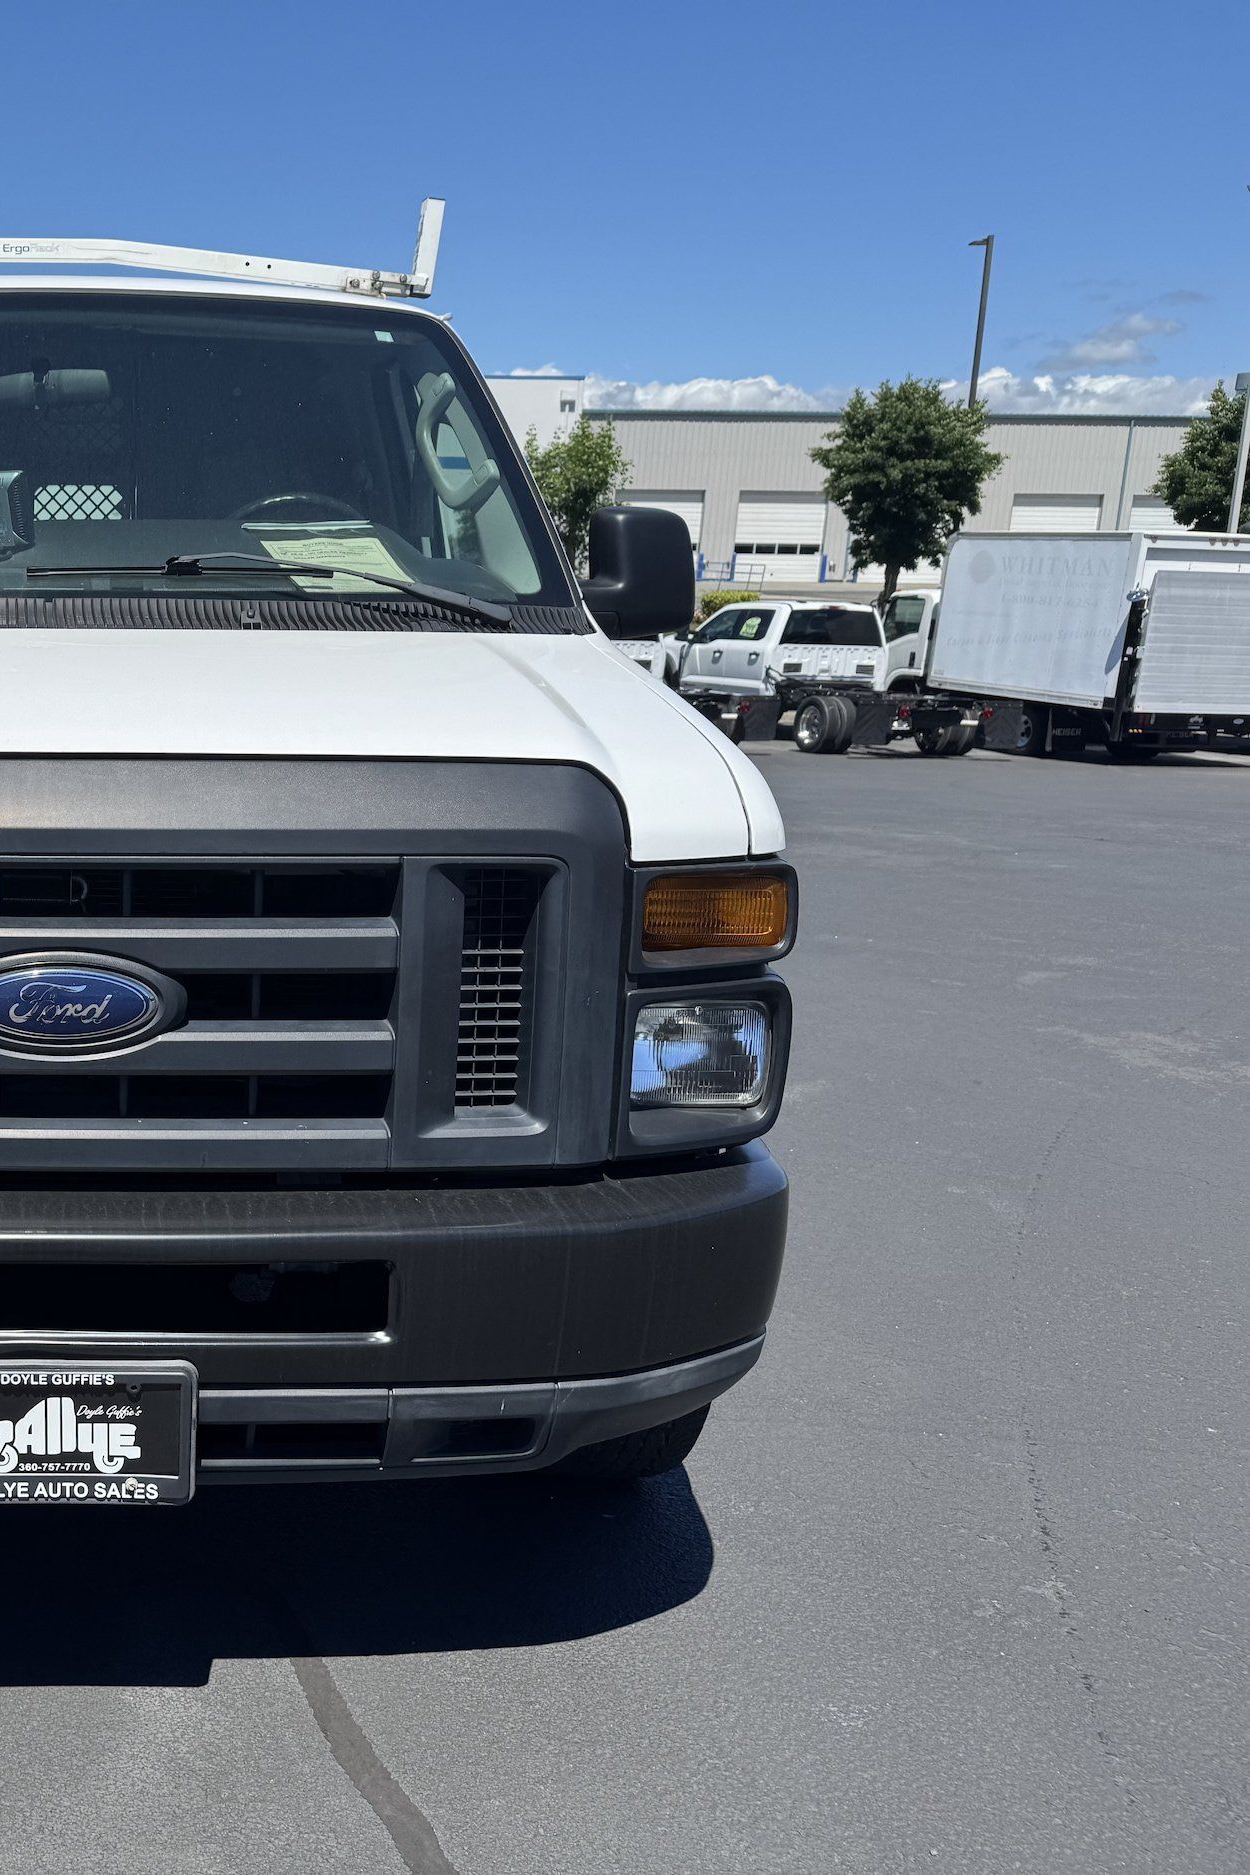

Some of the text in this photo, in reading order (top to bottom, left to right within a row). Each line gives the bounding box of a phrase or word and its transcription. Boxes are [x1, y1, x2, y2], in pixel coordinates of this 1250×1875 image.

[1001, 555, 1113, 577] WHITMAN
[8, 981, 113, 1024] Ford
[0, 1373, 115, 1386] DOYLE GUFFIE'S
[76, 1405, 142, 1419] Doyle Guffie's
[18, 1462, 91, 1472] 360-757-7770
[34, 1482, 89, 1499] AUTO
[94, 1483, 159, 1500] SALES
